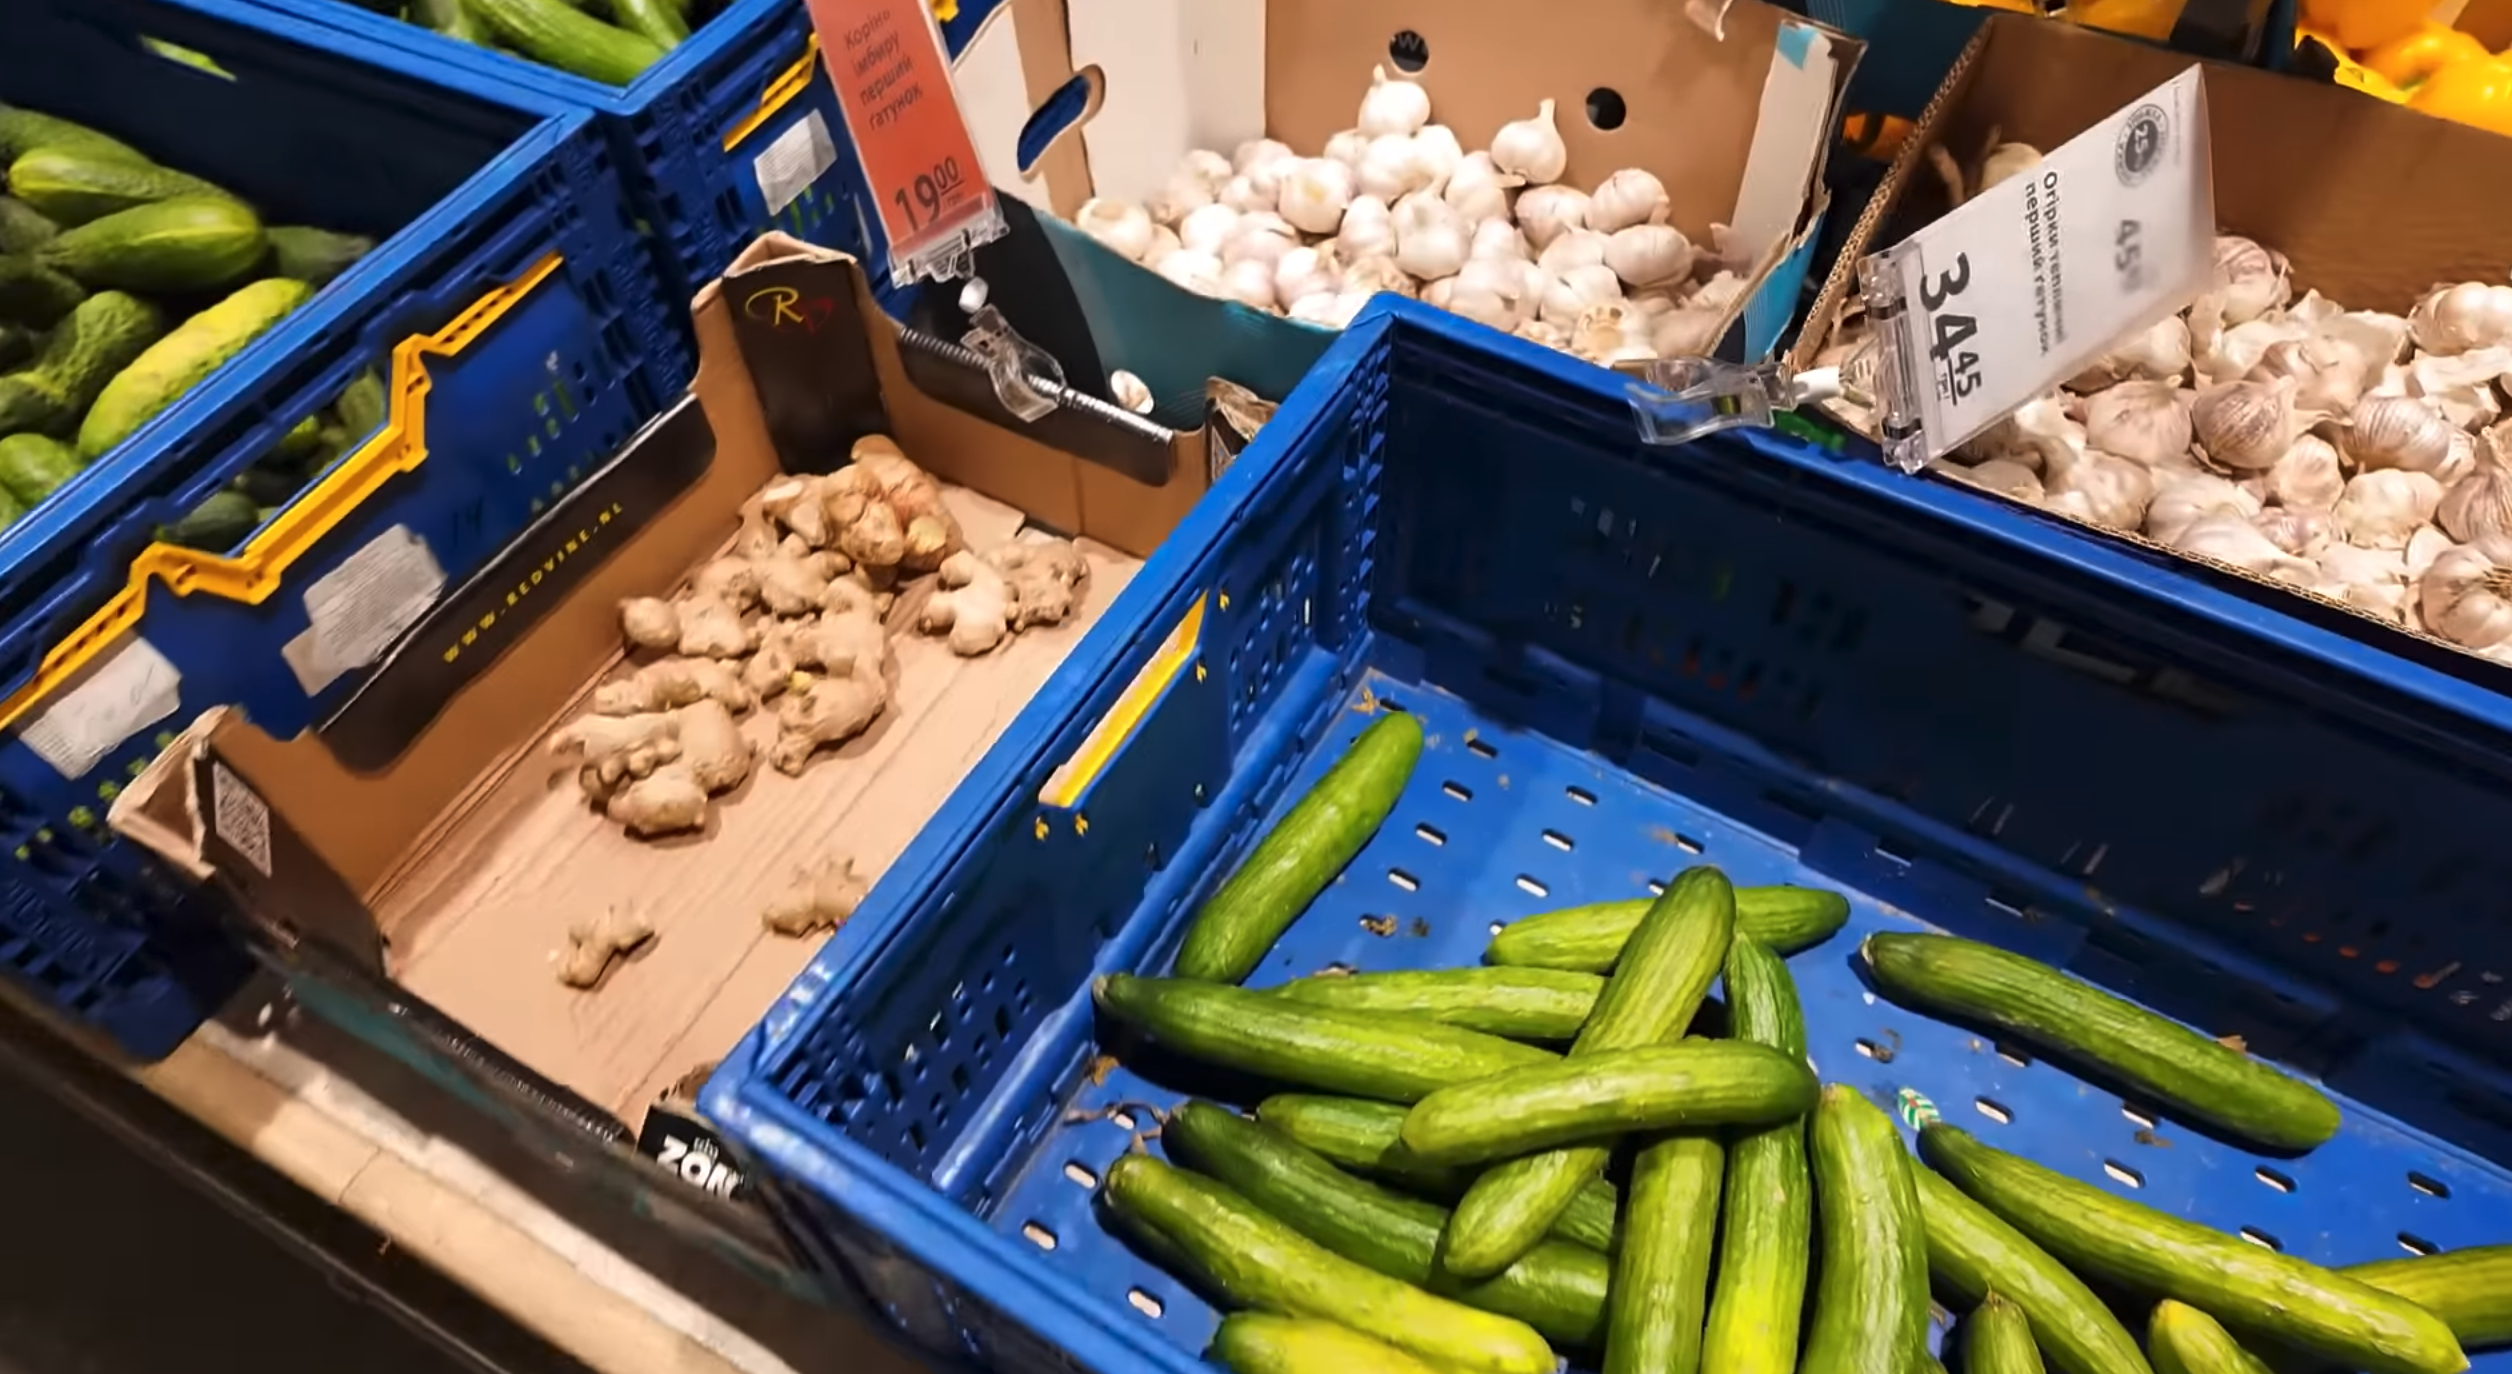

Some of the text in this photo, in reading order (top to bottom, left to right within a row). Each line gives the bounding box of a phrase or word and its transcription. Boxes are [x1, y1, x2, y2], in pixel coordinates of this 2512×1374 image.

[860, 56, 914, 106] перший
[2025, 182, 2045, 273] перший
[2043, 171, 2060, 248] Огірки
